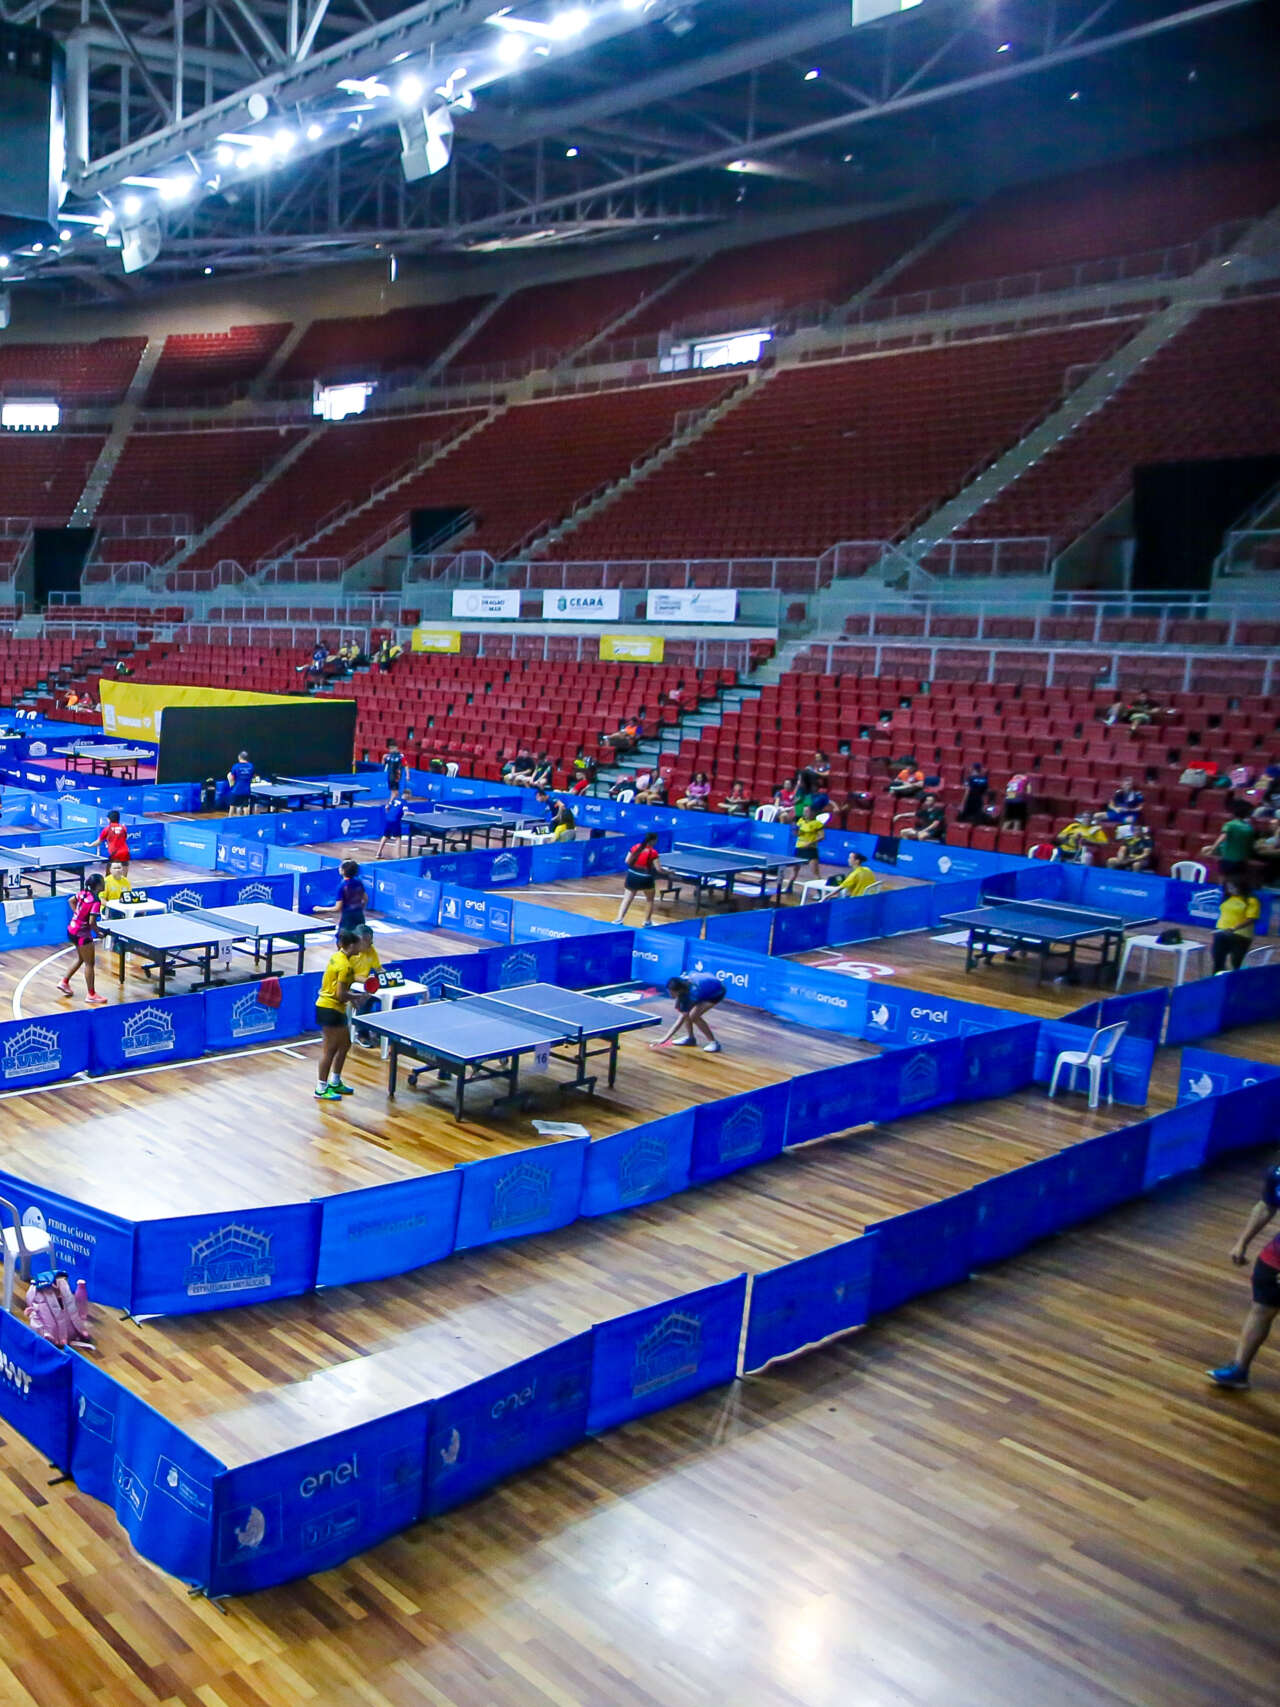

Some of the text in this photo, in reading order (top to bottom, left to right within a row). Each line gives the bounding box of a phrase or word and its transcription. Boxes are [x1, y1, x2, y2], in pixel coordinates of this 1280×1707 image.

[8, 874, 19, 887] 14
[123, 891, 147, 902] 5 2
[464, 899, 486, 912] enel
[220, 945, 231, 955] 15
[377, 973, 387, 984] 8
[715, 969, 749, 988] enel
[910, 1006, 949, 1025] enel
[536, 1053, 548, 1065] 16
[48, 1217, 97, 1245] FEDERAÇÃO DOS
[490, 1378, 538, 1420] enel
[299, 1451, 359, 1499] enel
